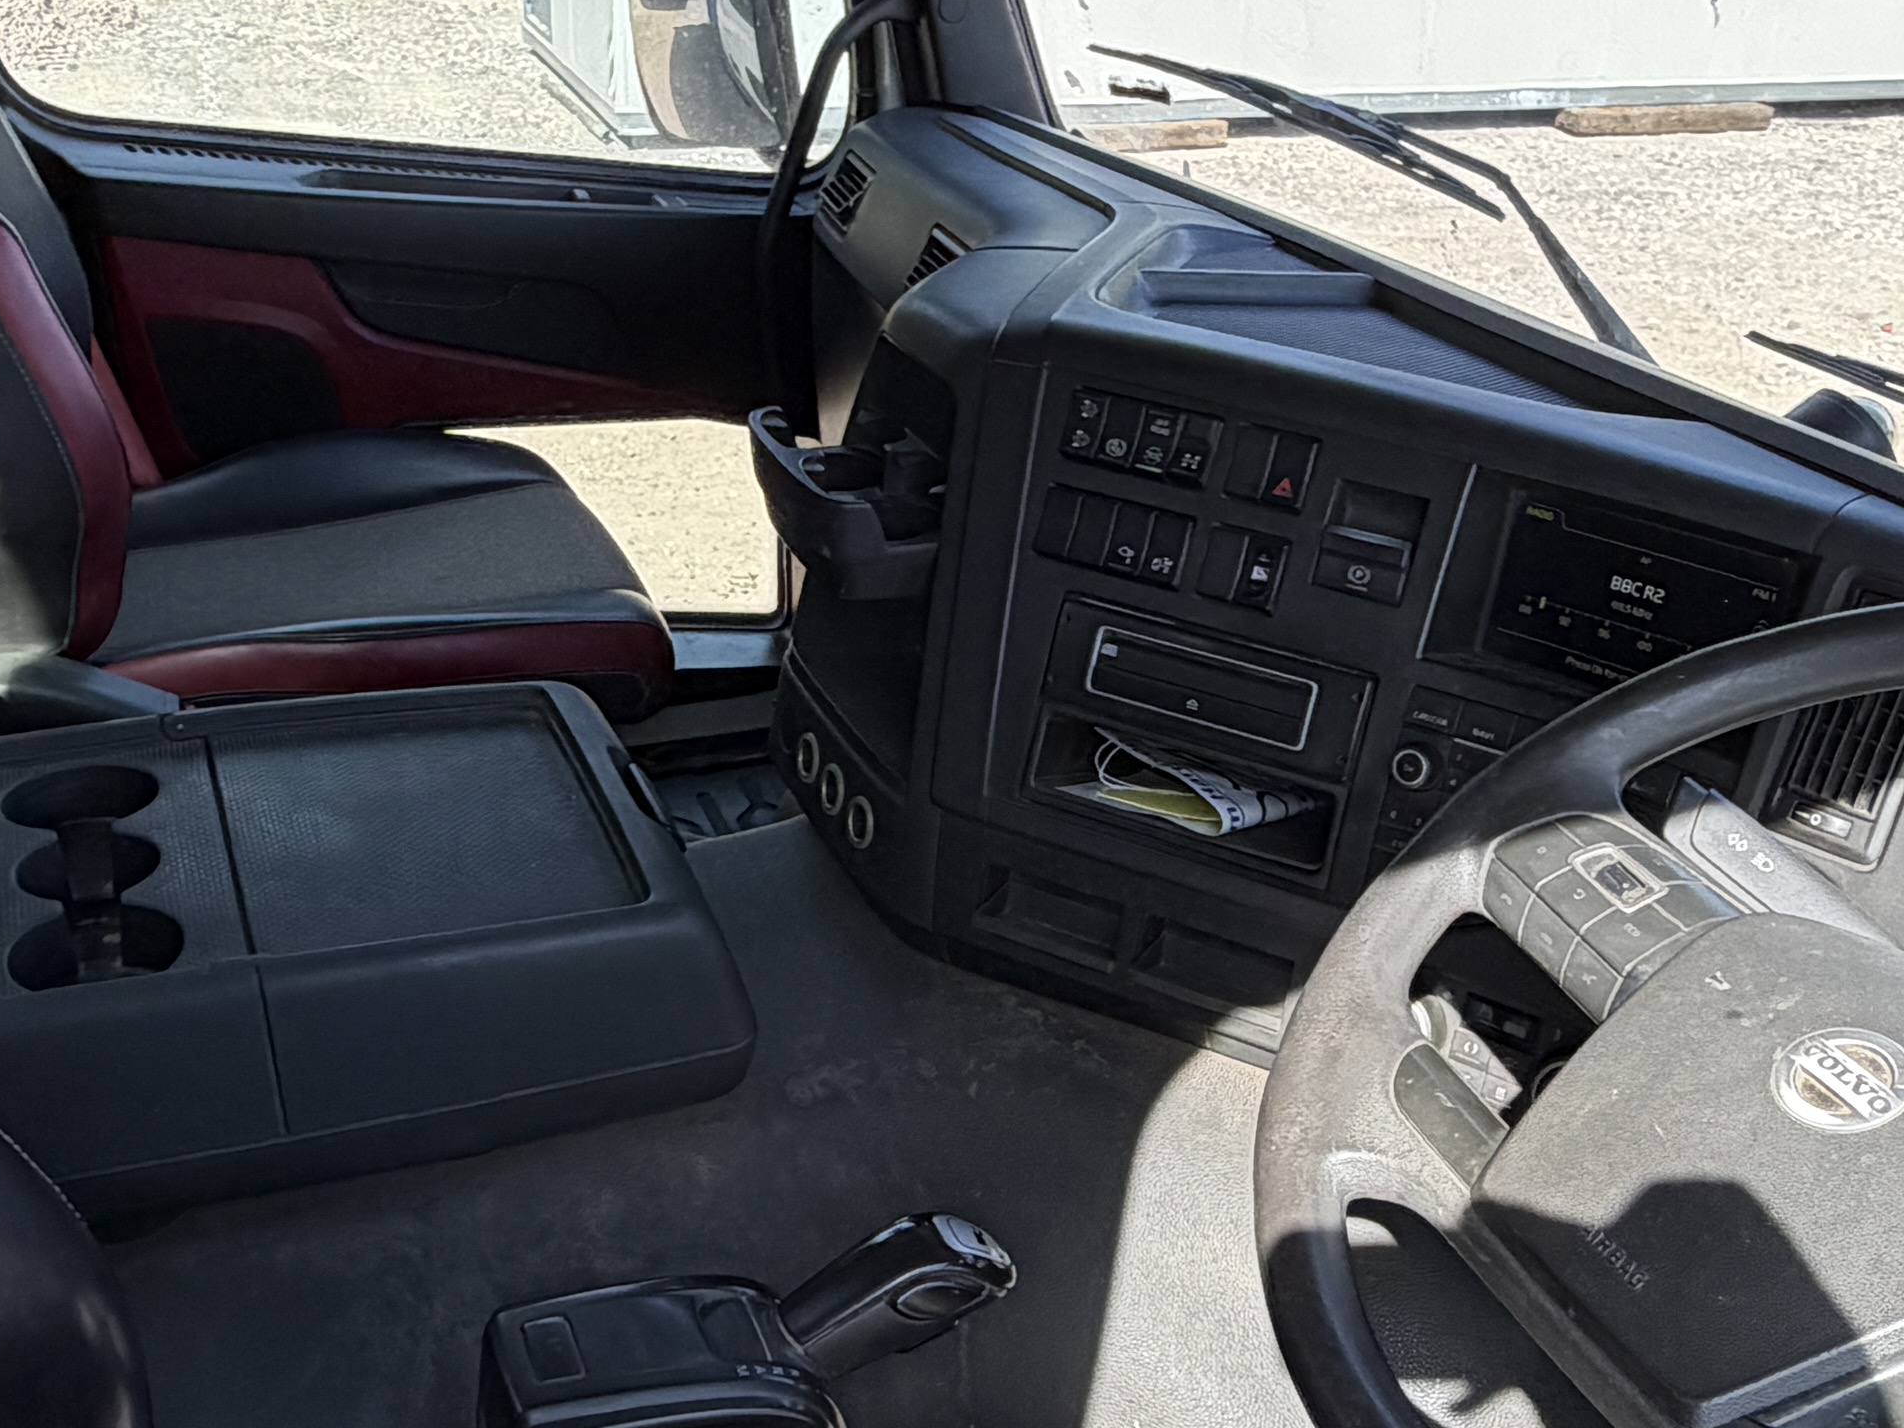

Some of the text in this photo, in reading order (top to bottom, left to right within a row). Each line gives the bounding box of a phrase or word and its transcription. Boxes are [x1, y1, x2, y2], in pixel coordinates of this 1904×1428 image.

[1610, 575, 1666, 605] BBC R2
[1803, 1043, 1893, 1114] VOLVO
[1580, 1226, 1649, 1292] AIRBAG
